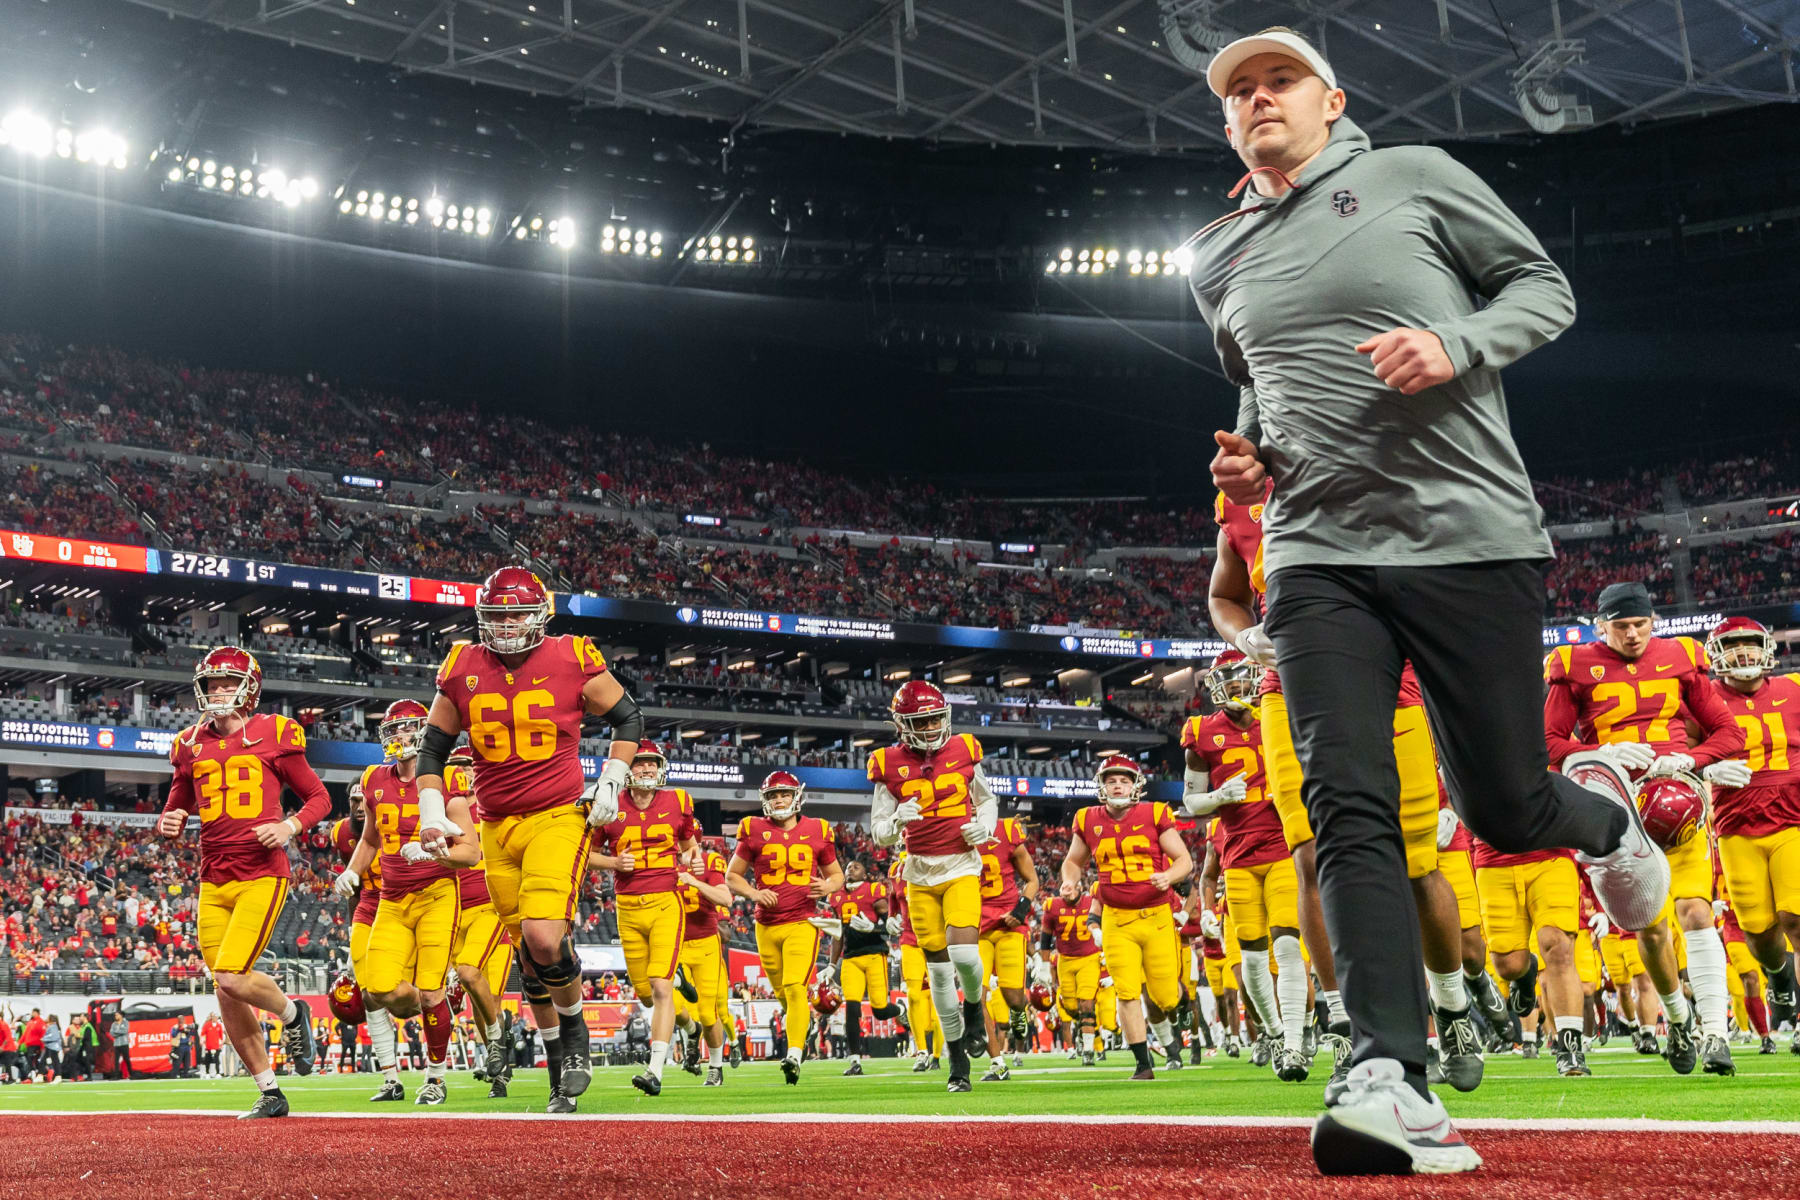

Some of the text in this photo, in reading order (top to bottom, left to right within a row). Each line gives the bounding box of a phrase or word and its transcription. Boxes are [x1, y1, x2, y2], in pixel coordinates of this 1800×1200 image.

[58, 541, 72, 560] 0
[90, 545, 110, 556] TOL
[171, 553, 230, 578] 27:24
[381, 577, 403, 598] 25
[442, 585, 460, 595] TOL
[702, 618, 764, 629] CHAMPIONSHIP
[722, 611, 763, 622] FOOTBALL
[829, 619, 838, 628] TO
[1592, 678, 1681, 745] 27
[2, 721, 90, 737] 2022 FOOTBALL
[469, 688, 558, 763] 66
[2, 732, 90, 745] CHAMPIONSHIP
[668, 771, 744, 783] CHAMPIONSHIP GAME
[671, 763, 739, 774] TO THE 2022 PAC-12
[192, 754, 264, 823] 38
[376, 803, 421, 855] 87
[616, 824, 675, 869] 42
[761, 843, 814, 886] 39
[1095, 835, 1155, 884] 46
[138, 1032, 171, 1043] HEALTH
